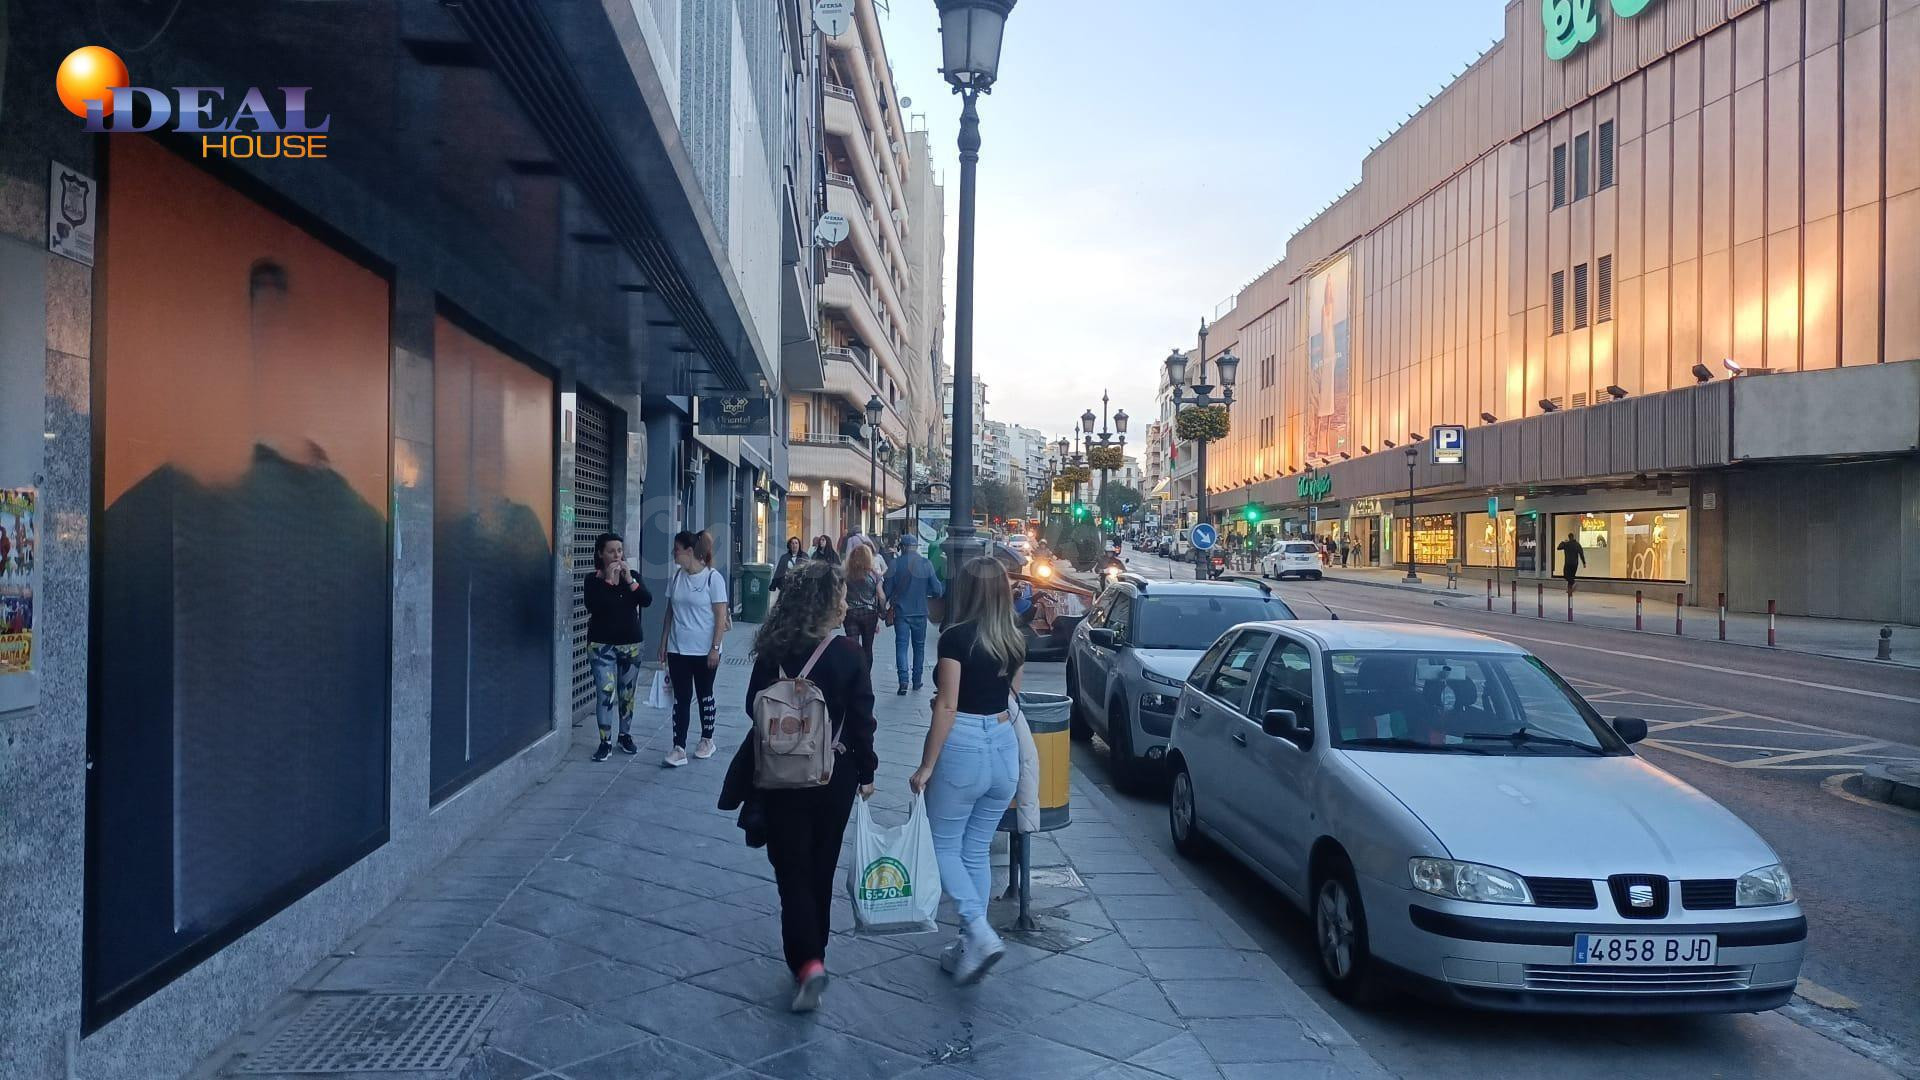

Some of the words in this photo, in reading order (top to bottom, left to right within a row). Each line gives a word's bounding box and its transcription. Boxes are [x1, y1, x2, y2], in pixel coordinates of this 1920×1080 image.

[1439, 429, 1458, 449] P
[1590, 938, 1655, 962] 4858
[1665, 938, 1711, 962] BJD
